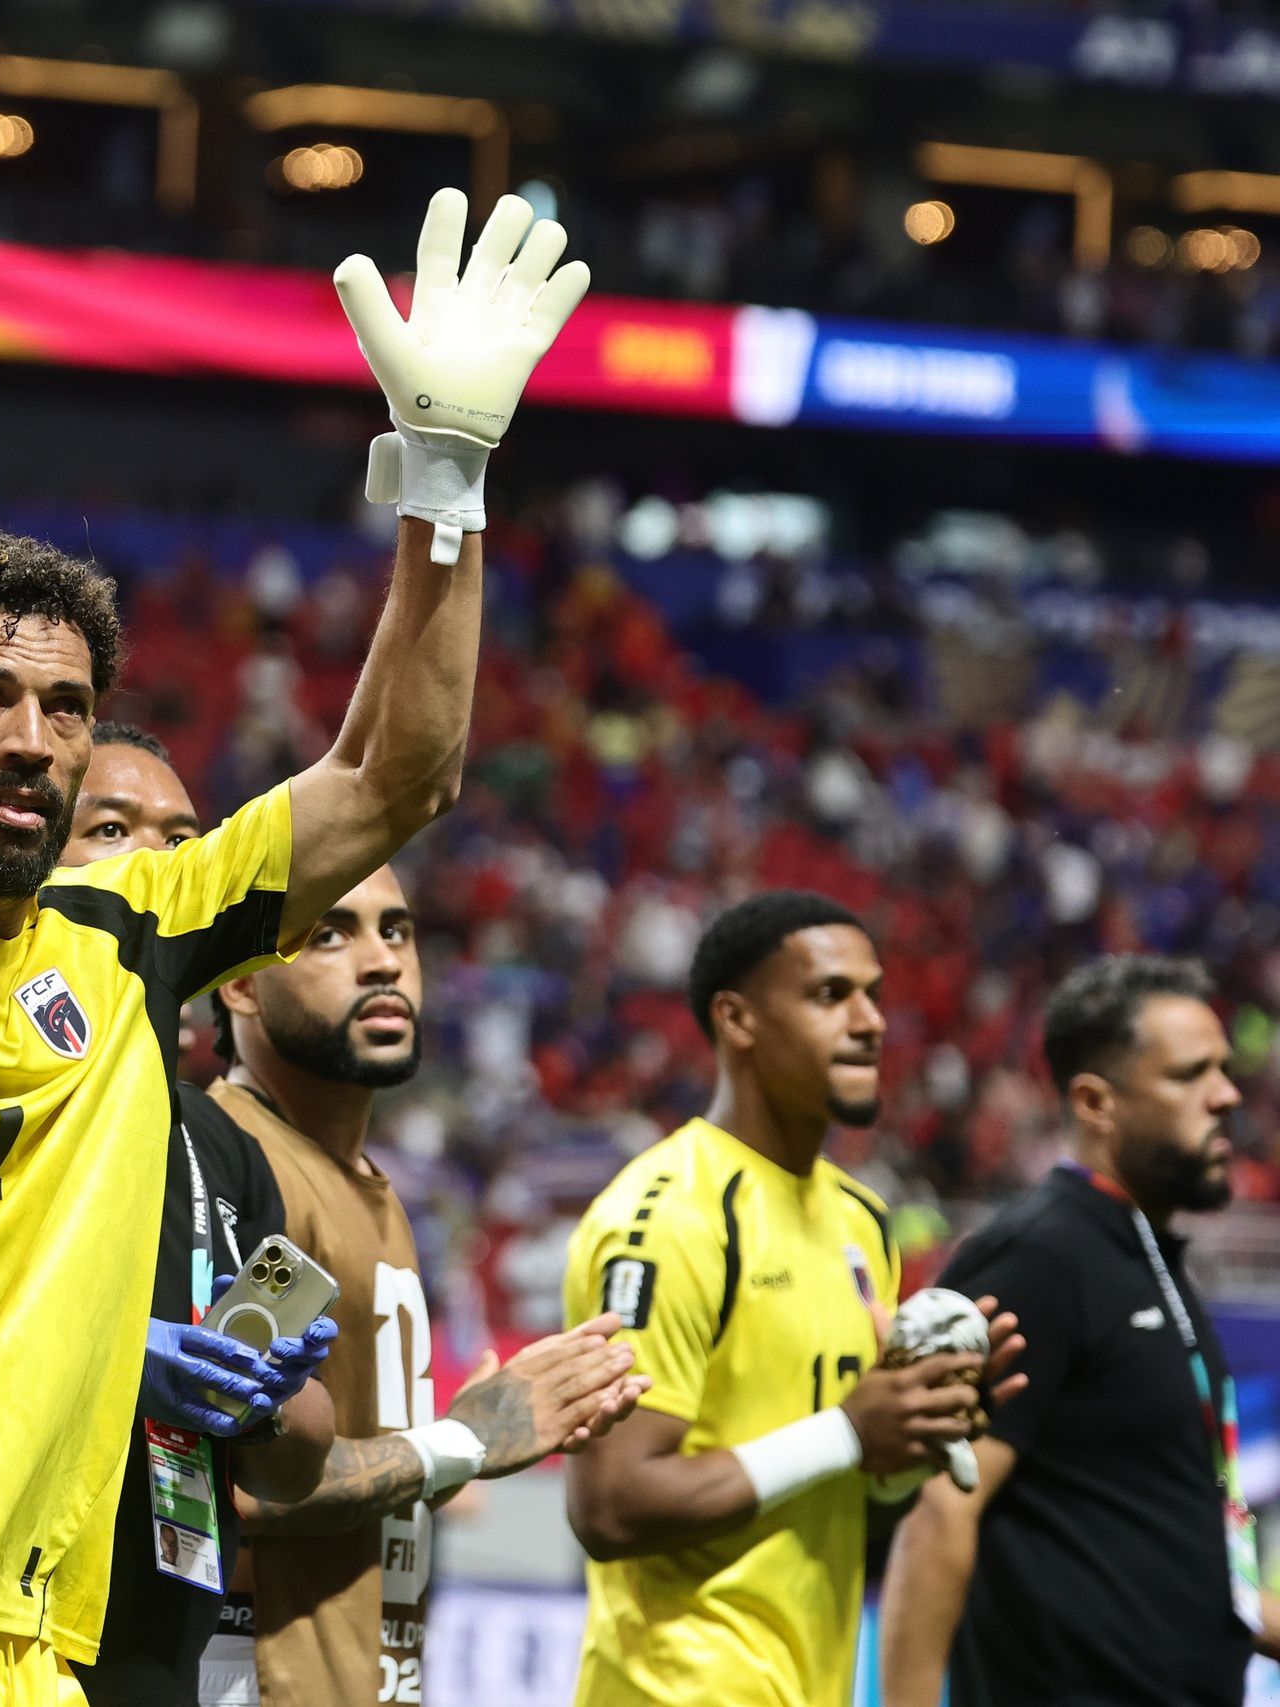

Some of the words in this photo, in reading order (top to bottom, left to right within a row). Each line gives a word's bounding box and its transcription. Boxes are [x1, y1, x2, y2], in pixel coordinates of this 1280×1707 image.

[433, 400, 464, 413] ELITE
[467, 408, 505, 420] SPORT
[20, 973, 56, 1006] FCF
[193, 1201, 208, 1235] FIFA
